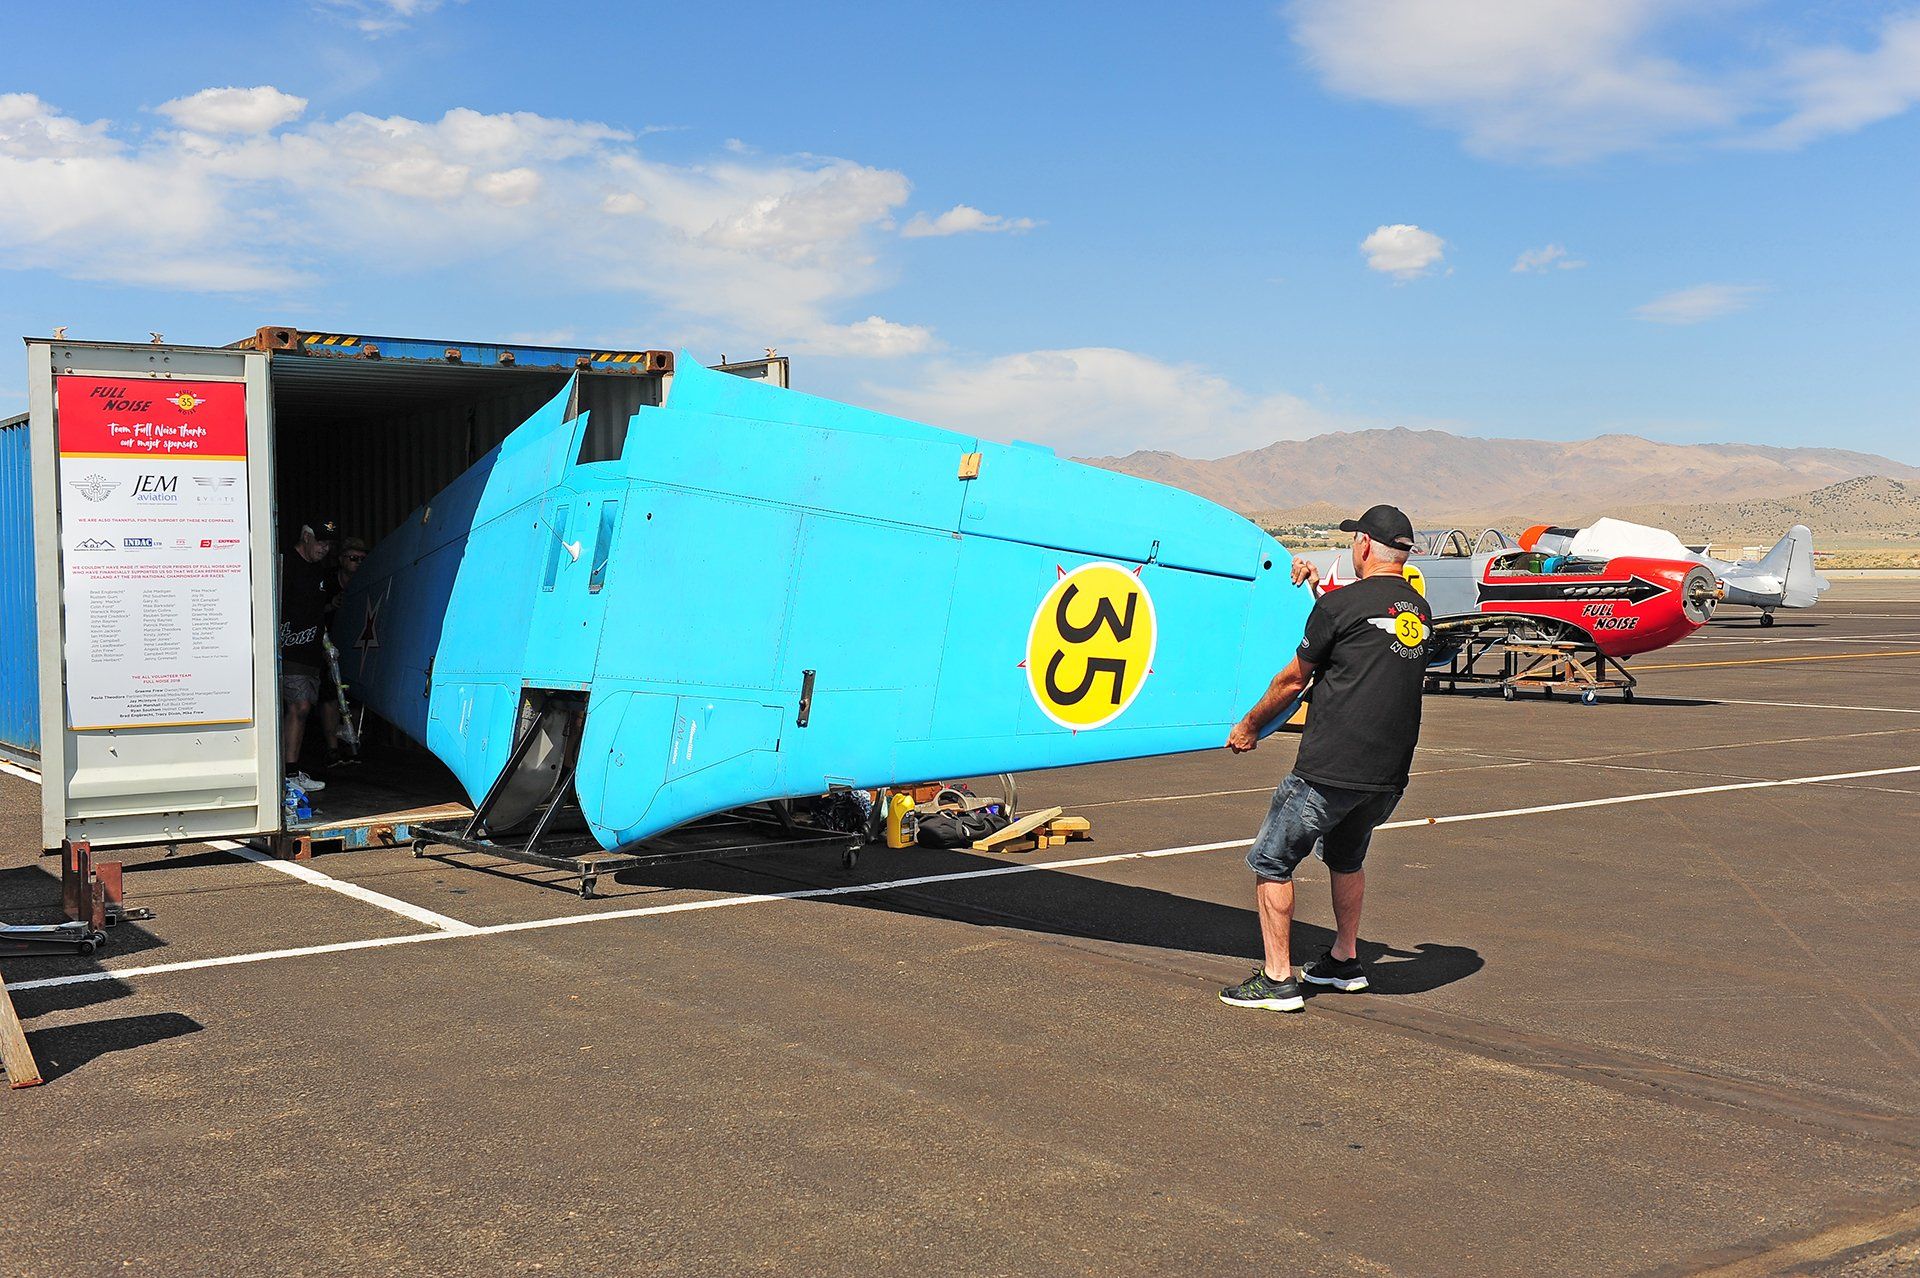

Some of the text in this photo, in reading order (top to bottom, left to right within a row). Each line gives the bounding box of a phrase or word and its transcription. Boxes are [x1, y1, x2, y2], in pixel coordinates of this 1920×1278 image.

[90, 386, 126, 398] FULL
[103, 400, 152, 412] NOISE
[182, 398, 192, 406] 35
[107, 422, 131, 436] Team
[133, 422, 152, 436] Full
[154, 424, 176, 437] Noise
[120, 438, 198, 452] our major sponsors
[130, 476, 178, 498] JEM
[138, 493, 178, 502] aviation
[1394, 601, 1420, 615] FULL
[1582, 604, 1614, 617] FULL
[1402, 619, 1419, 639] 35
[1594, 617, 1640, 630] NOISE
[281, 626, 318, 647] OISE
[1045, 583, 1138, 706] 35
[1390, 640, 1424, 659] NOISE
